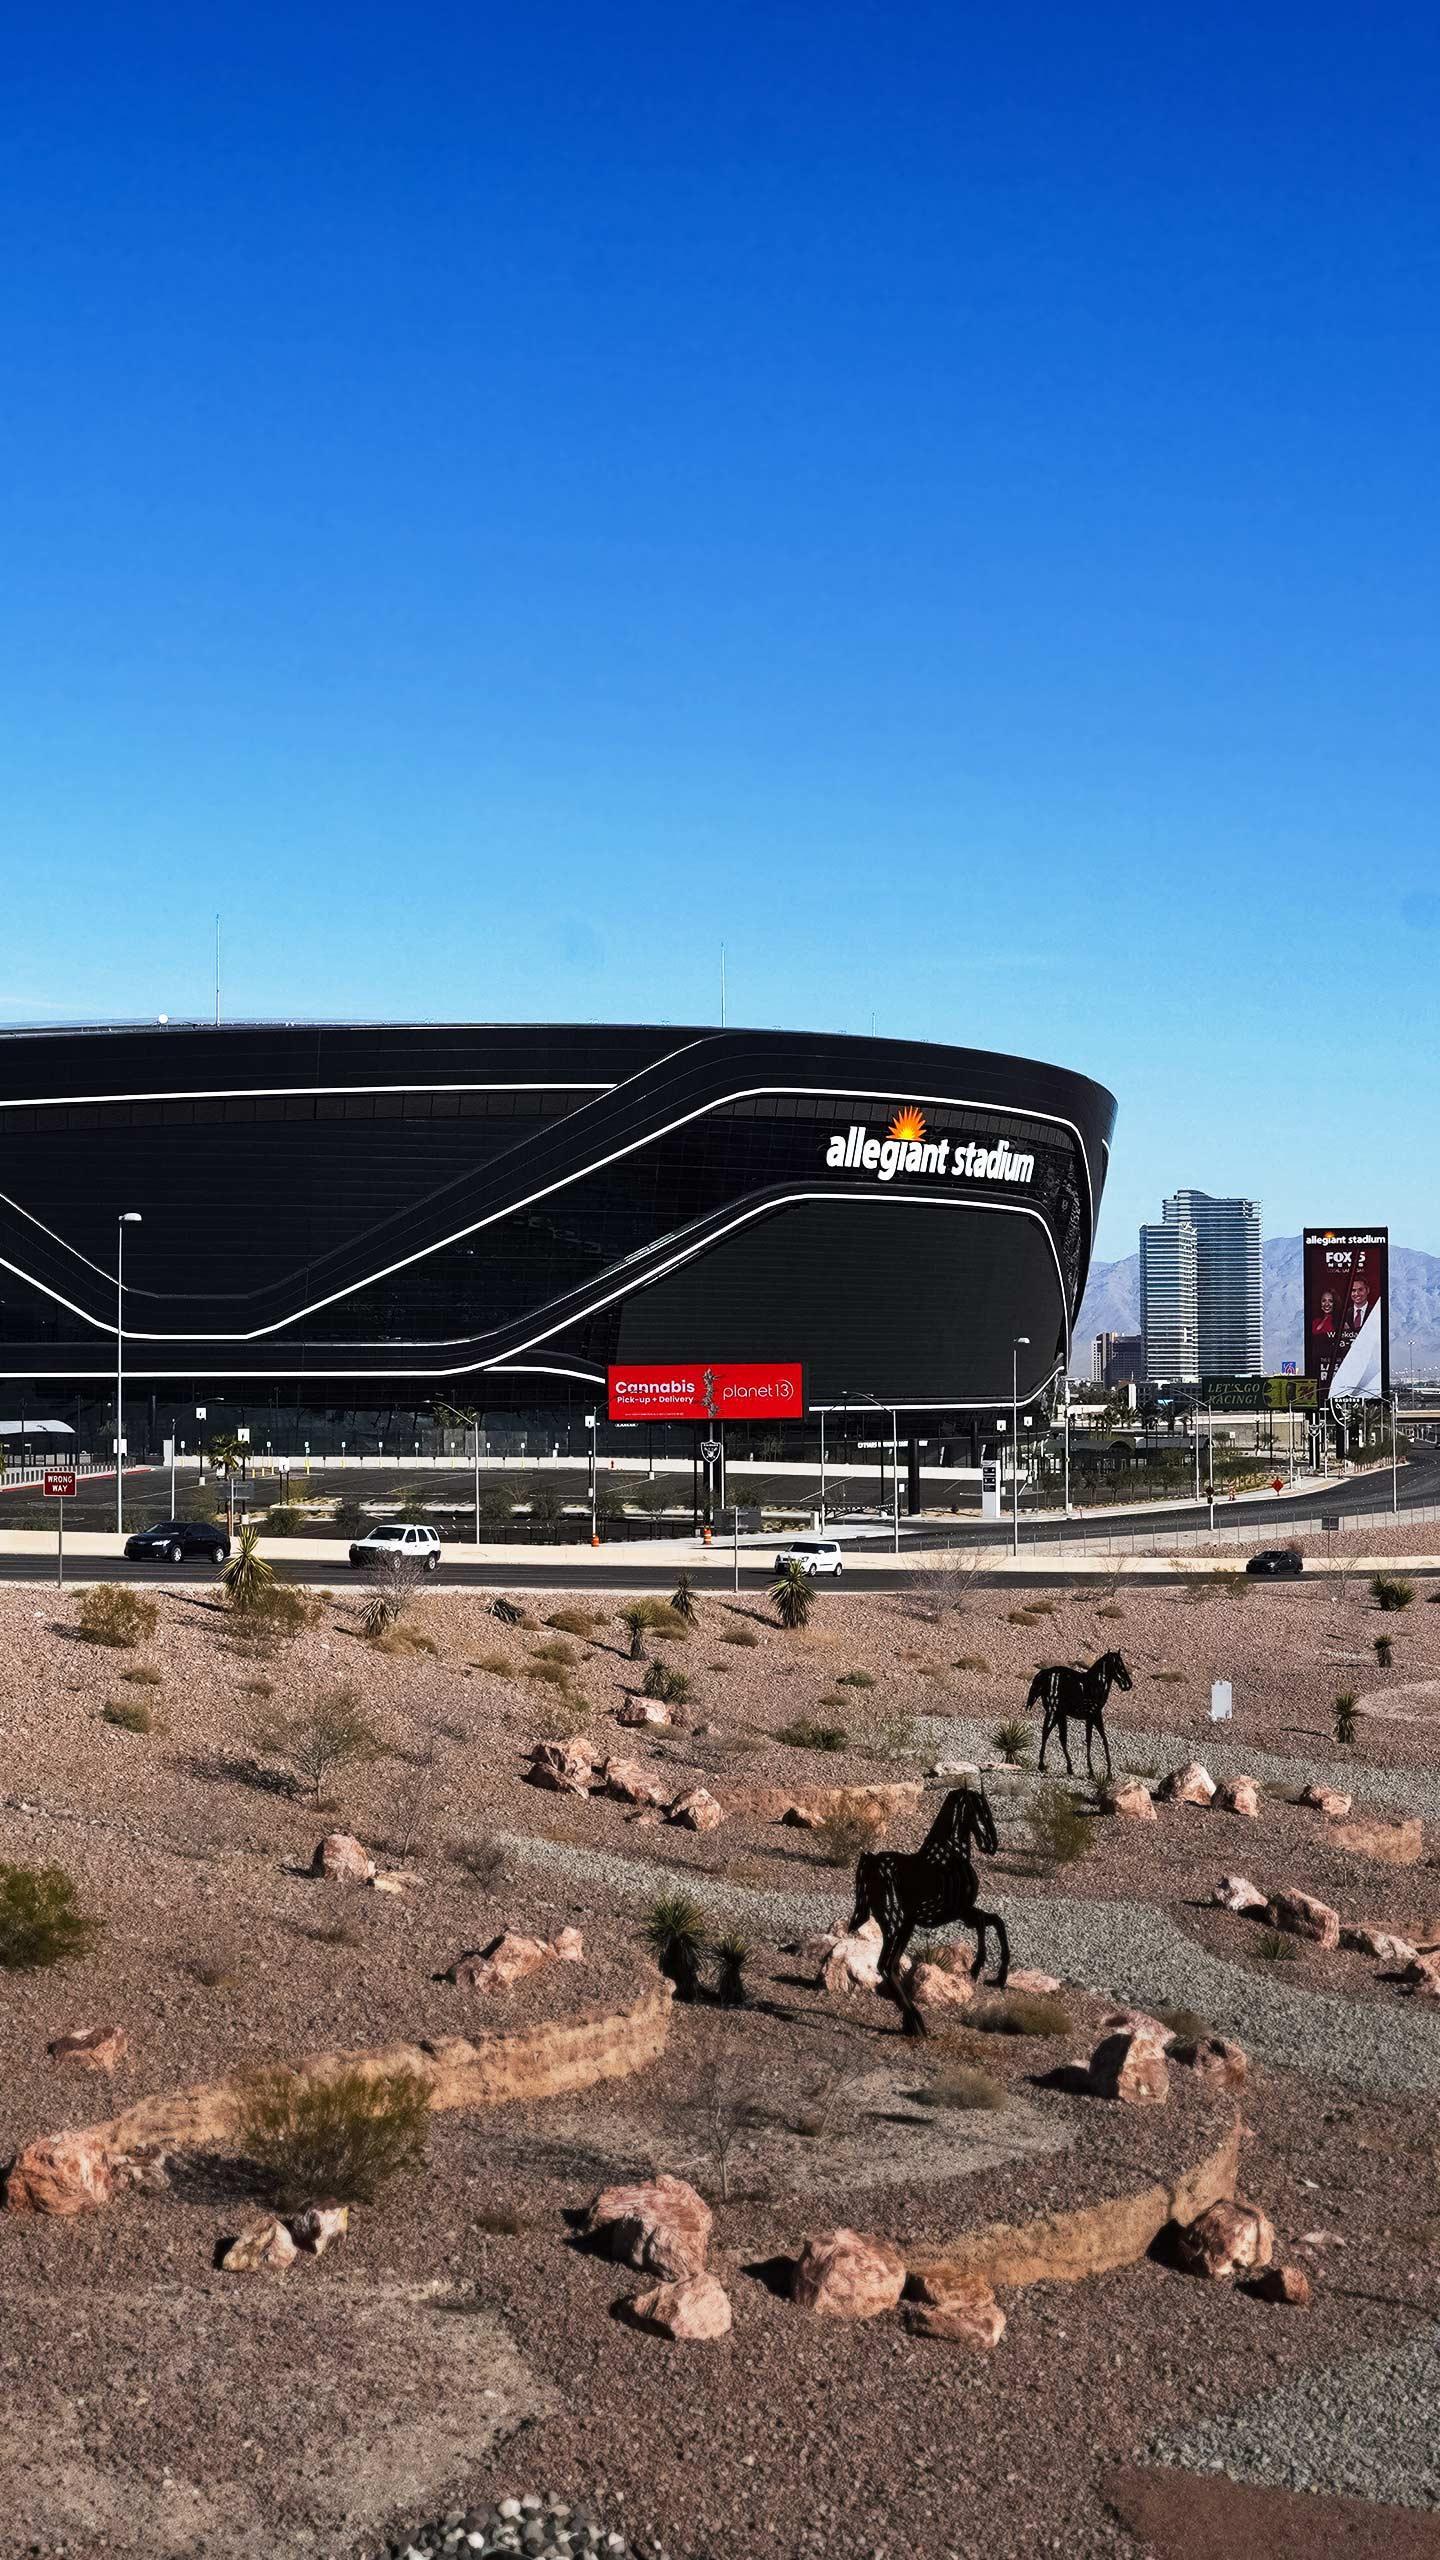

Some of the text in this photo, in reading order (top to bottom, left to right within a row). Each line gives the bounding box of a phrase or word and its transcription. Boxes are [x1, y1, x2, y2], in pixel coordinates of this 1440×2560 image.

[825, 1125, 1036, 1184] allegiant stadium
[1305, 1234, 1386, 1246] allegiant stadium
[1325, 1251, 1353, 1263] FOX
[615, 1379, 696, 1394] Cannabis
[723, 1384, 773, 1399] planet
[1207, 1383, 1260, 1393] LET'S GO
[617, 1395, 651, 1405] Pick-up
[658, 1394, 695, 1405] Delivery
[1208, 1394, 1257, 1404] RACING!
[47, 1475, 73, 1484] WRONG
